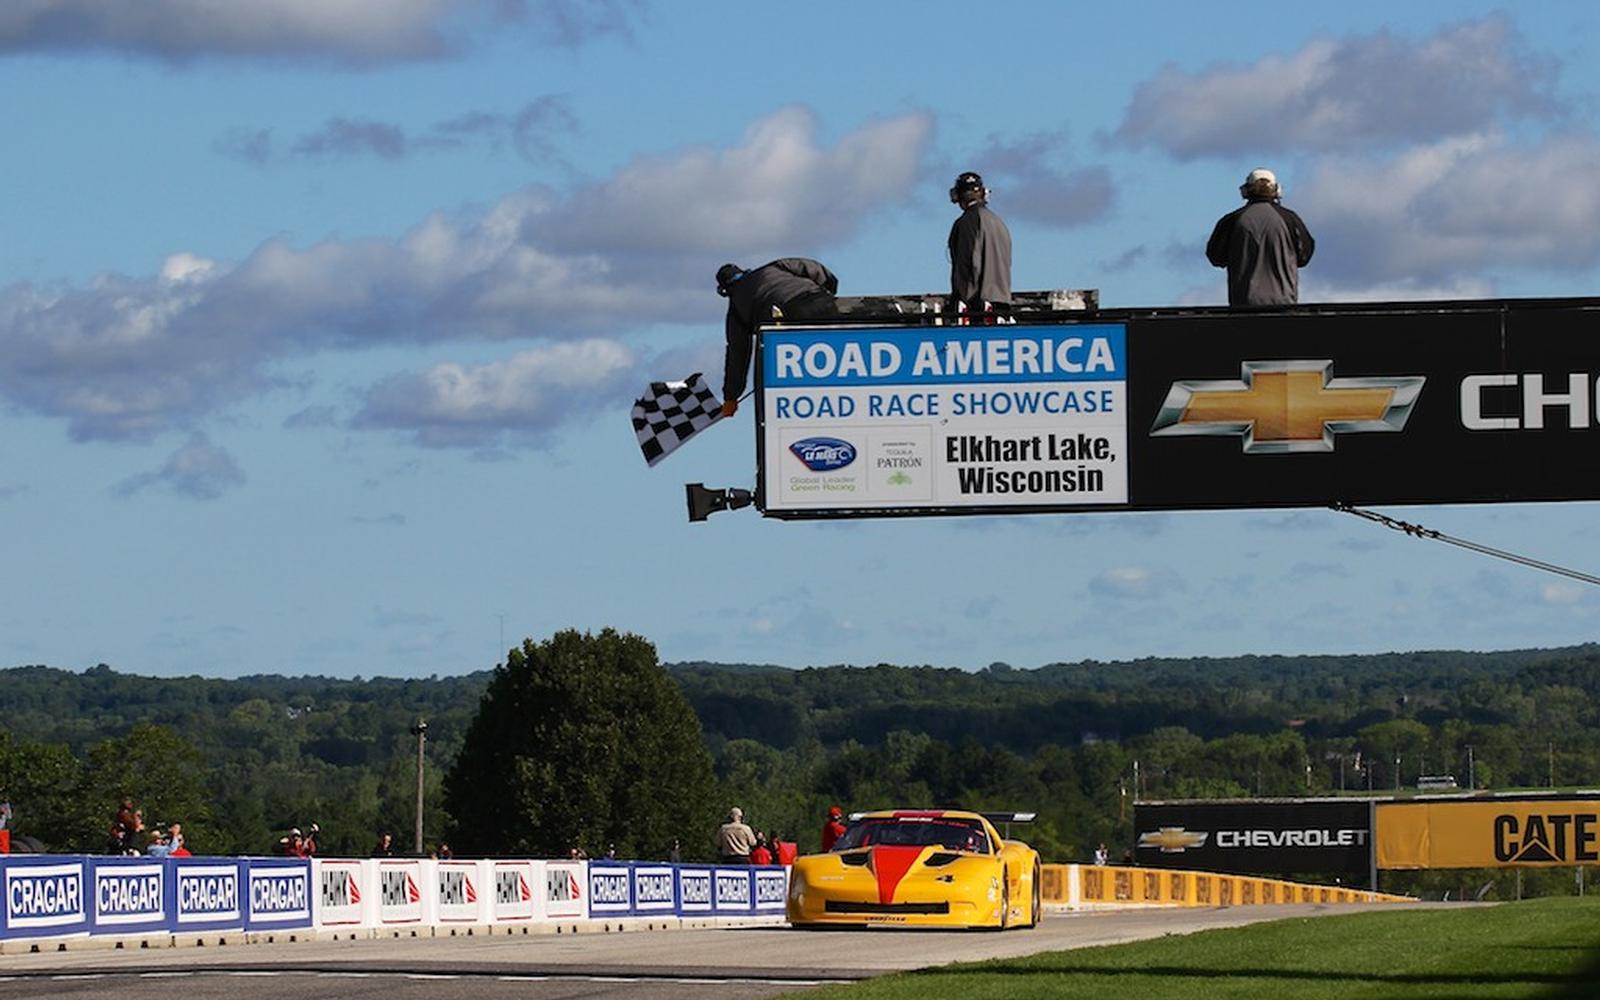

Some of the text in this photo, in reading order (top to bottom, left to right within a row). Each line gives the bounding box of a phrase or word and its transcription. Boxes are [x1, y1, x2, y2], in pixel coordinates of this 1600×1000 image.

[776, 337, 1116, 379] ROAD AMERICA
[776, 390, 1113, 419] ROAD RACE SHOWCASE
[1460, 373, 1600, 430] CH
[877, 456, 922, 468] PATRÓN
[946, 433, 1116, 463] Elkhart Lake,
[958, 465, 1103, 494] Wisconsin
[1216, 829, 1369, 847] CHEVROLET
[1494, 814, 1598, 862] CATE
[10, 876, 78, 914] CRAGAR
[99, 876, 160, 912] CRAGAR
[180, 877, 234, 911] CRAGAR
[252, 877, 305, 910] CRAGAR
[593, 876, 628, 901] CRAGAR
[638, 876, 671, 901] CRAGAR
